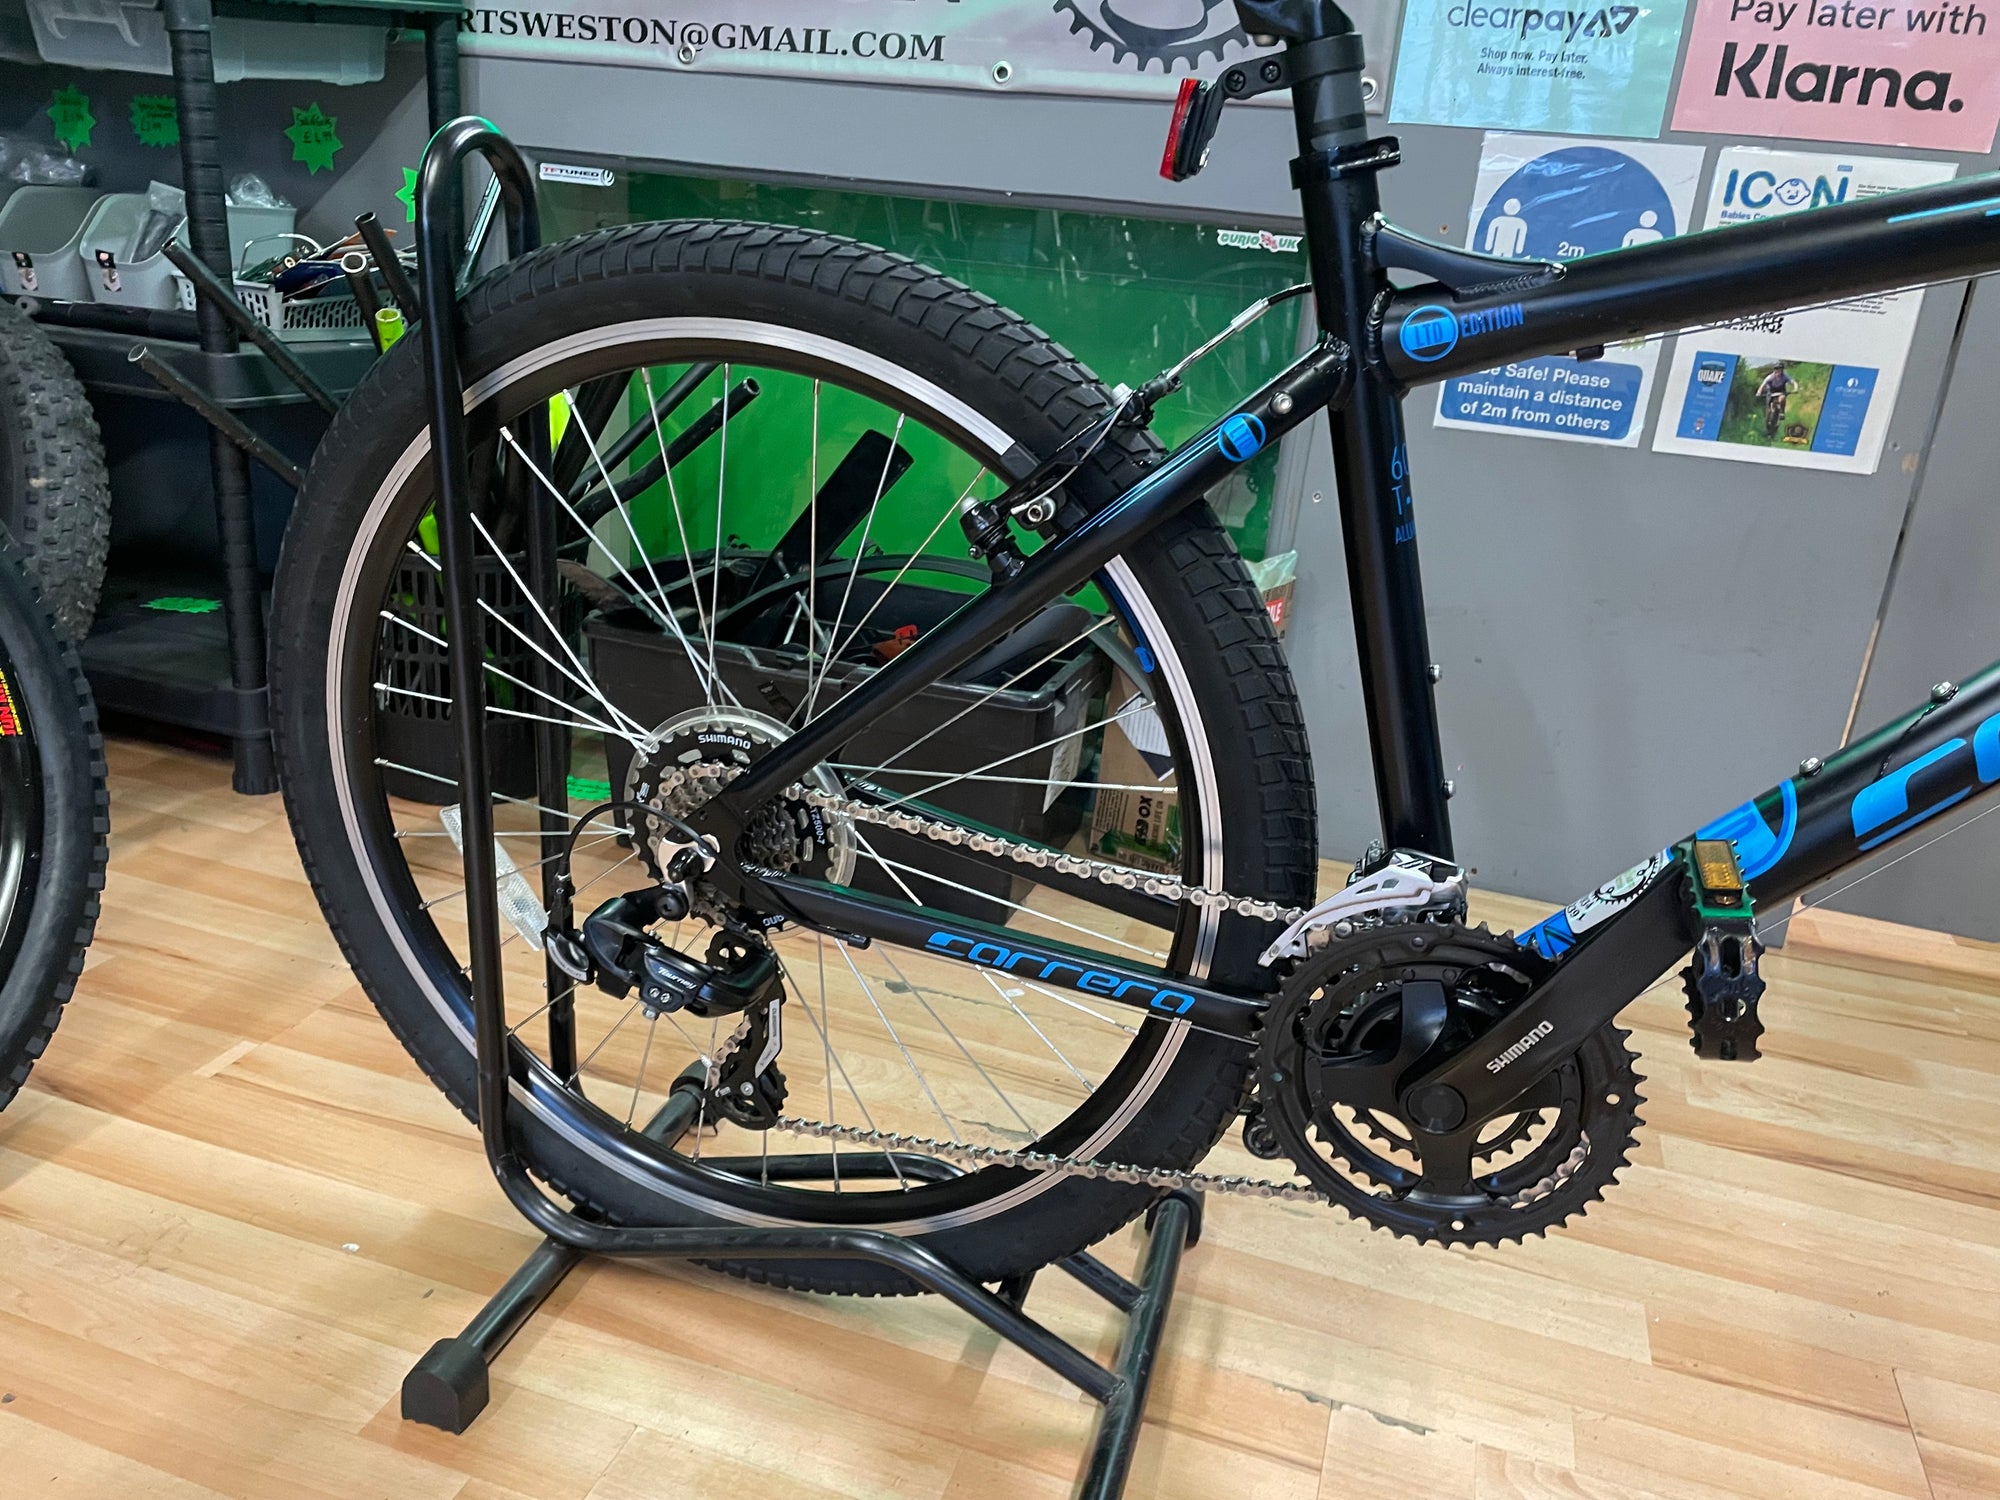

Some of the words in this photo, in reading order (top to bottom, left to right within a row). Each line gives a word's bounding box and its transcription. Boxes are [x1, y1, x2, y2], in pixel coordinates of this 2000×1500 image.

[1807, 0, 1895, 30] later
[1907, 2, 1986, 35] with
[1476, 63, 1514, 76] Always
[1516, 66, 1586, 80] interest-free.
[1479, 47, 1508, 61] Shop
[1510, 51, 1535, 61] now.
[1538, 51, 1559, 65] Pay
[1560, 52, 1589, 63] later.
[1714, 42, 1964, 113] Klarna.
[1556, 241, 1585, 257] 2m
[1414, 321, 1444, 347] LTD
[1461, 303, 1526, 338] EDITION
[1505, 364, 1550, 382] Safe!
[1552, 368, 1611, 389] Please
[1457, 381, 1530, 401] maintain
[1533, 389, 1545, 402] a
[1549, 390, 1623, 412] distance
[1460, 401, 1478, 415] of
[1480, 405, 1508, 419] 2m
[1511, 406, 1550, 424] from
[1554, 411, 1611, 432] others
[697, 733, 751, 750] SHIMANO
[657, 966, 697, 990] Tourney
[924, 931, 1196, 1015] carrera
[1486, 1020, 1554, 1074] SHIMANO
